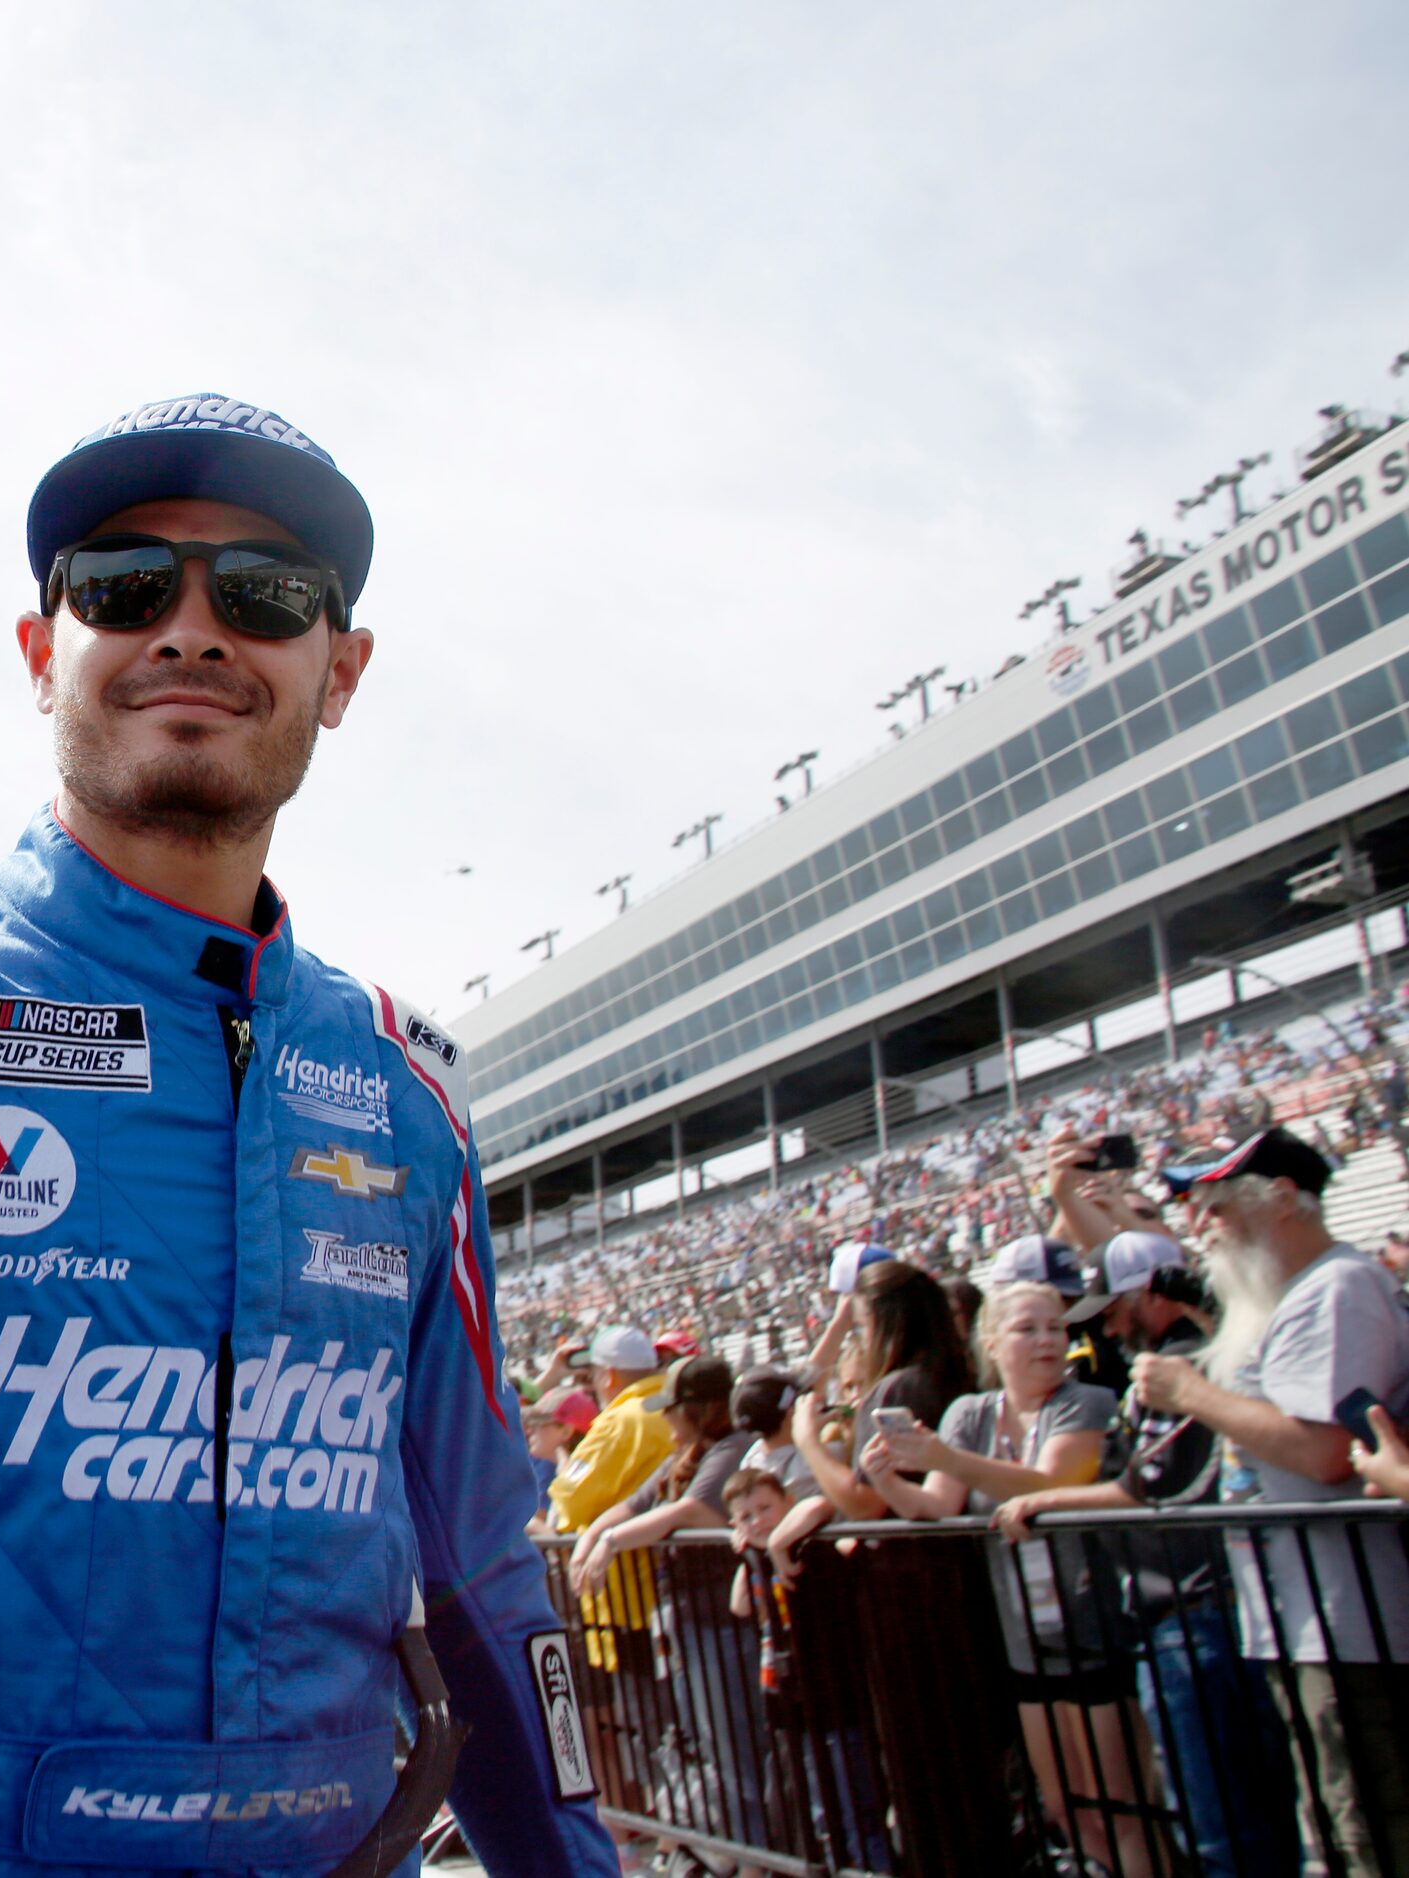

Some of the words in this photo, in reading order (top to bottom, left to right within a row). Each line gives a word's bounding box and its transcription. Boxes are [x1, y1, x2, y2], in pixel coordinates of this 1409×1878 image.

[103, 398, 311, 450] Hendrick
[1095, 570, 1214, 665] TEXAS
[1221, 476, 1367, 593] MOTOR
[1379, 442, 1409, 496] S
[21, 1003, 119, 1037] NASCAR
[39, 1047, 125, 1071] SERIES
[275, 1044, 390, 1102] Hendrick
[297, 1083, 388, 1115] MOTORSPORTS
[62, 1434, 379, 1513] cars.com
